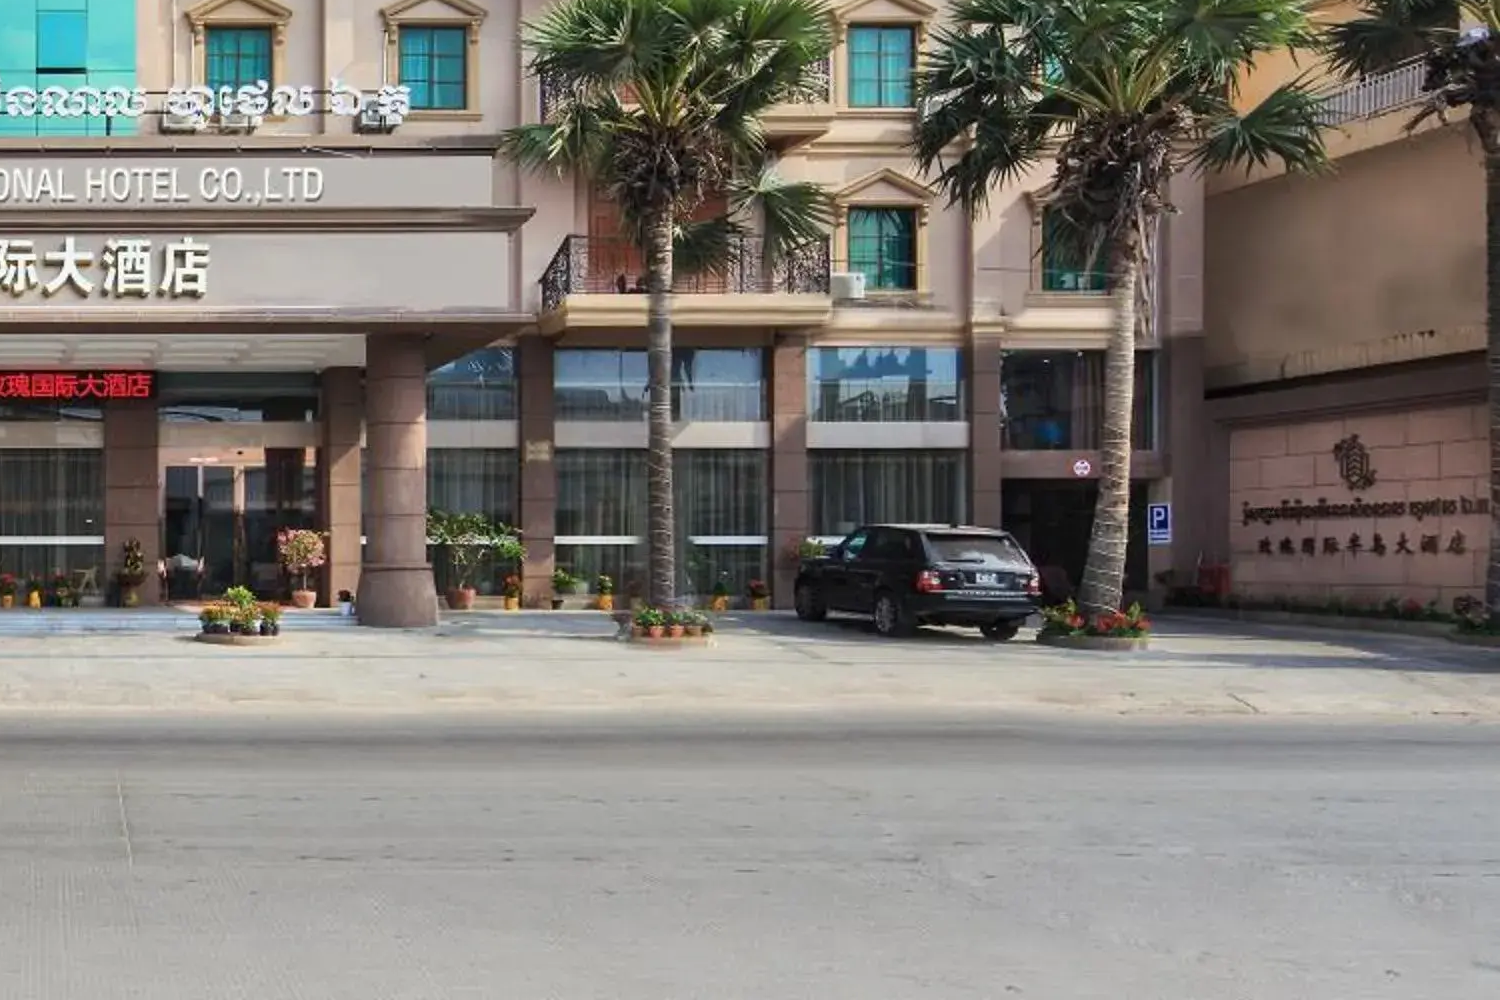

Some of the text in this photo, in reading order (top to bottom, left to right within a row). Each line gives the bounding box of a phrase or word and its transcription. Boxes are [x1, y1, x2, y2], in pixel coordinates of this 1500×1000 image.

[86, 168, 191, 202] HOTEL
[199, 167, 325, 205] CO.,LTD
[1152, 507, 1165, 528] P
